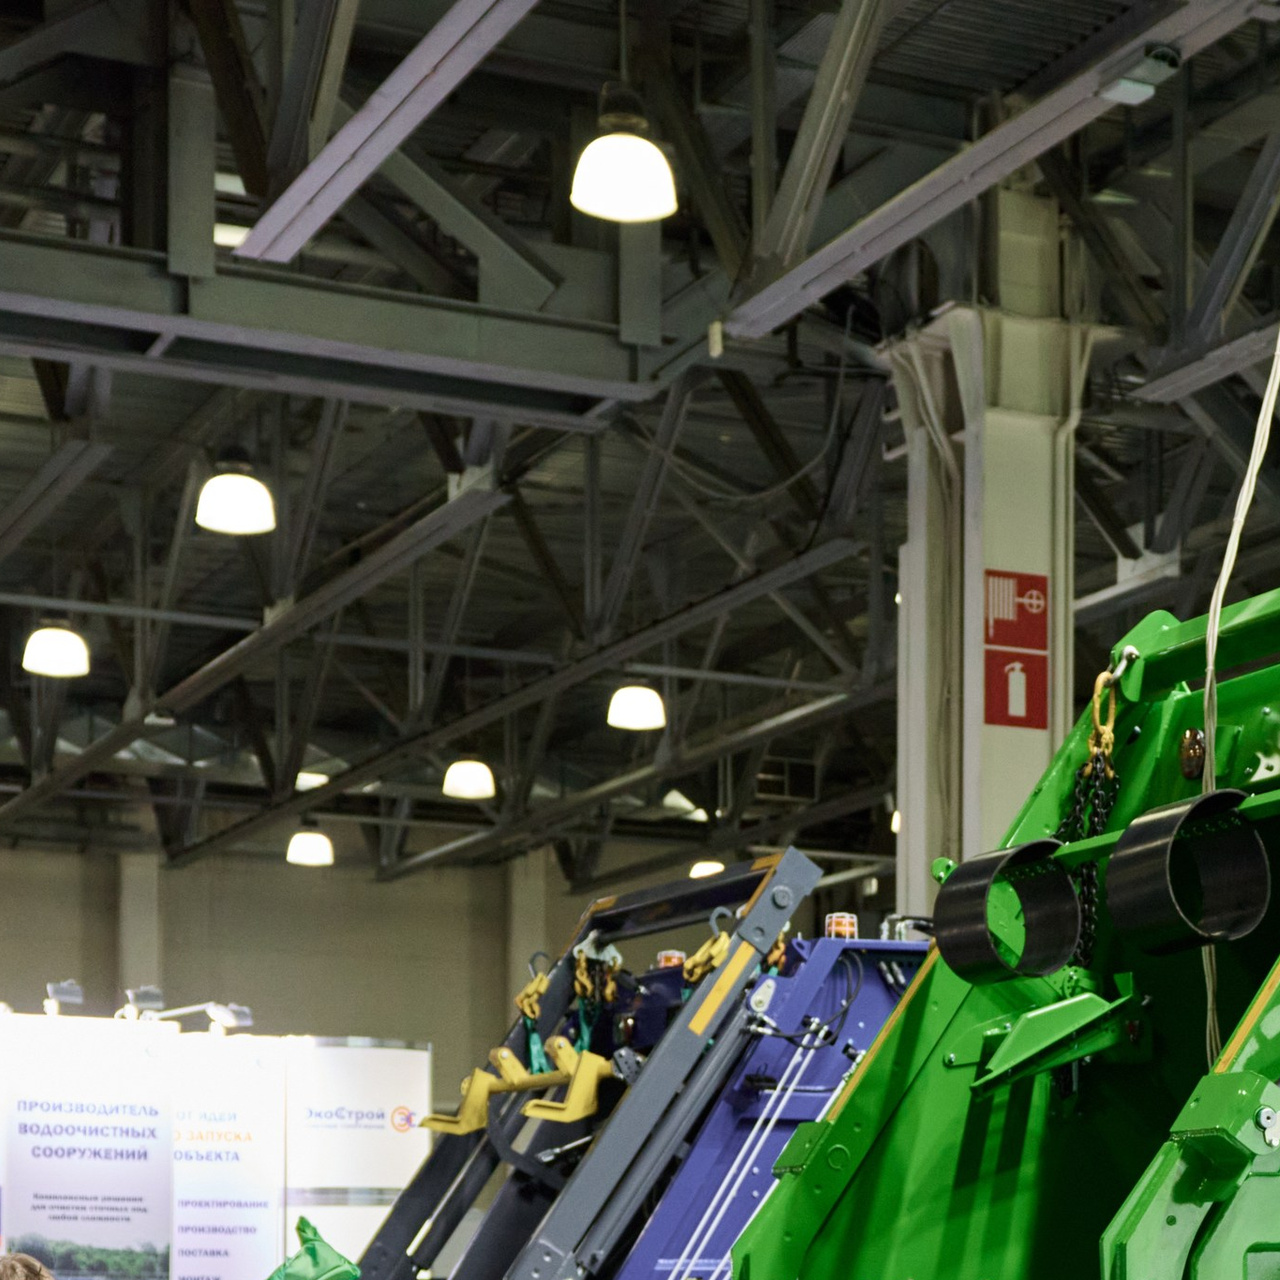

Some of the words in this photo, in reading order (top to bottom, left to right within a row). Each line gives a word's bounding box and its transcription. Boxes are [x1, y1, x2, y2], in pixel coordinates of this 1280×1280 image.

[17, 1100, 160, 1117] ПРОИЗВОДИТЕЛЬ
[306, 1106, 385, 1125] ЭкоСтрой
[18, 1122, 158, 1139] ВОДООЧИСТНЫХ
[186, 1130, 253, 1142] ЗАПУСКА
[31, 1144, 149, 1161] СООРУЖЕНИЙ
[173, 1149, 241, 1162] ОБЪЕКТА
[178, 1200, 269, 1209] ПРОЕКТИРОВАНИЕ
[178, 1225, 257, 1235] ПРОИЗВОДСТВО
[178, 1249, 230, 1258] ПОСТАВКА
